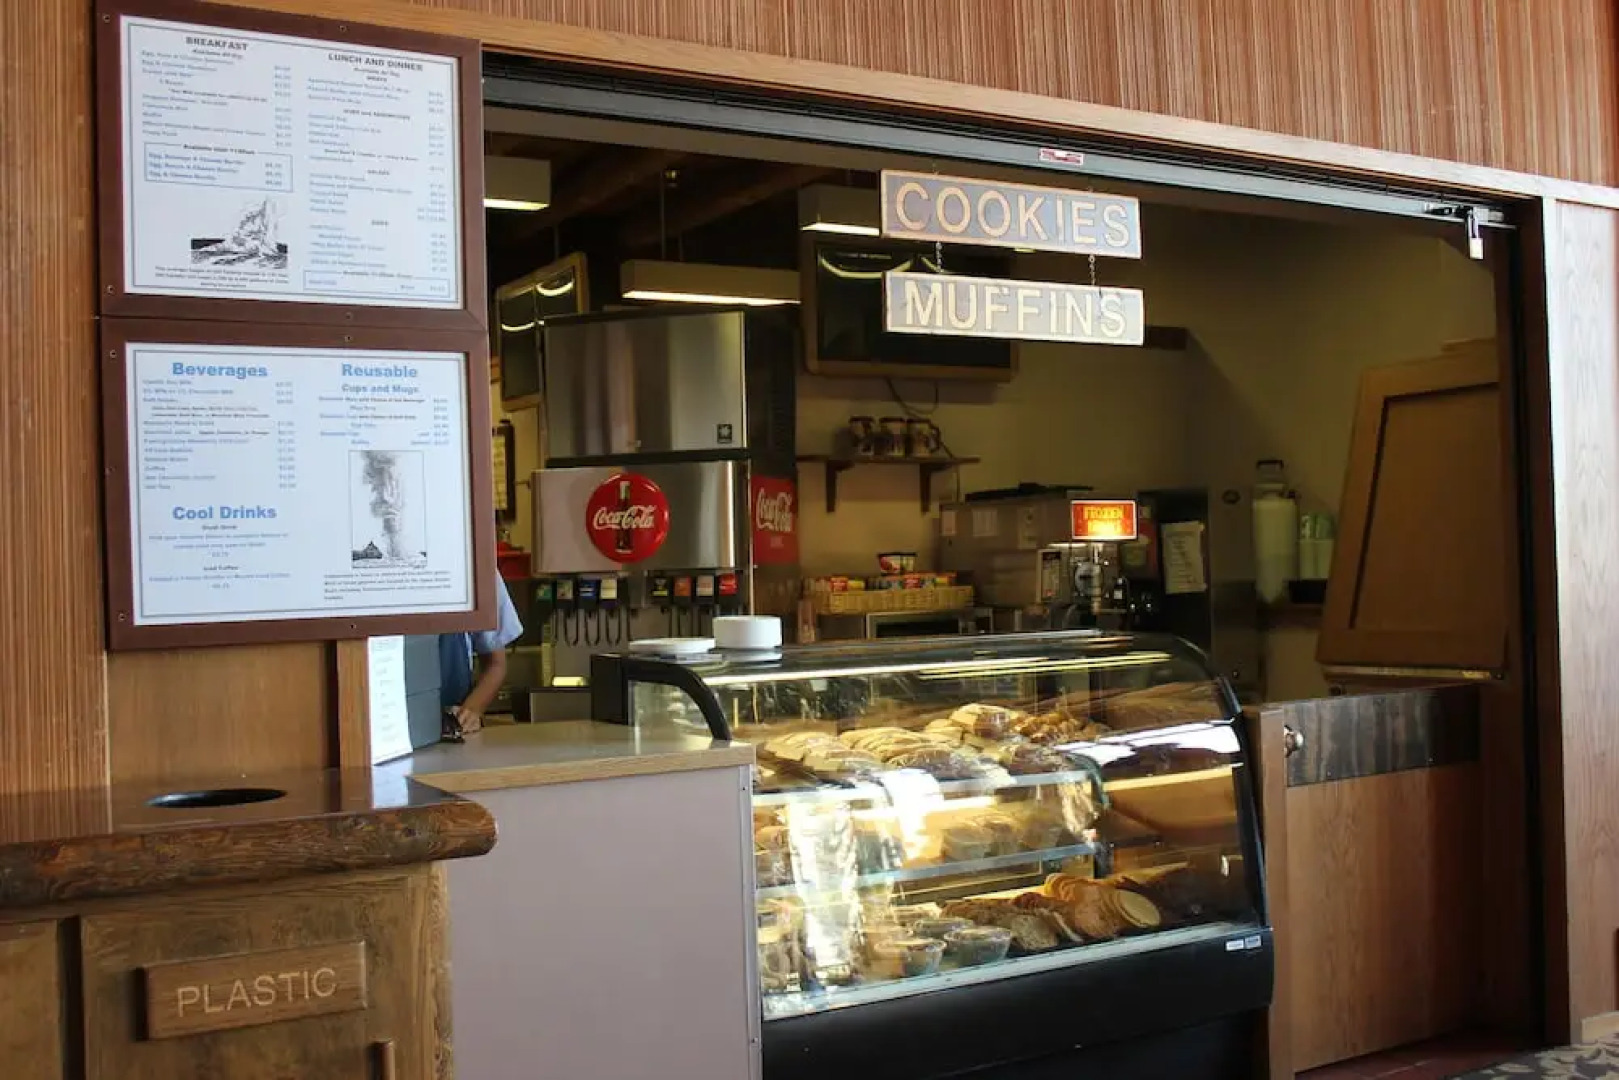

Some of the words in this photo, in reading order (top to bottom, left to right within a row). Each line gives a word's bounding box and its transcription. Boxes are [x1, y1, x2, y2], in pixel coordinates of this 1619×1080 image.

[186, 36, 249, 51] BREAKFAST
[328, 52, 362, 64] LUNCH
[364, 57, 385, 67] AND
[386, 59, 424, 72] DINNER
[896, 182, 1130, 248] COOKIES
[903, 279, 1127, 338] MUFFINS
[172, 362, 268, 379] Beverages
[341, 362, 418, 378] Reusable
[341, 383, 368, 395] Cups
[370, 384, 390, 394] and
[391, 383, 419, 396] Mugs
[172, 506, 214, 520] Cool
[219, 505, 278, 520] Drinks
[593, 504, 657, 531] Coca-Cola
[756, 486, 793, 532] Coca-Cola
[176, 967, 337, 1018] PLASTIC
